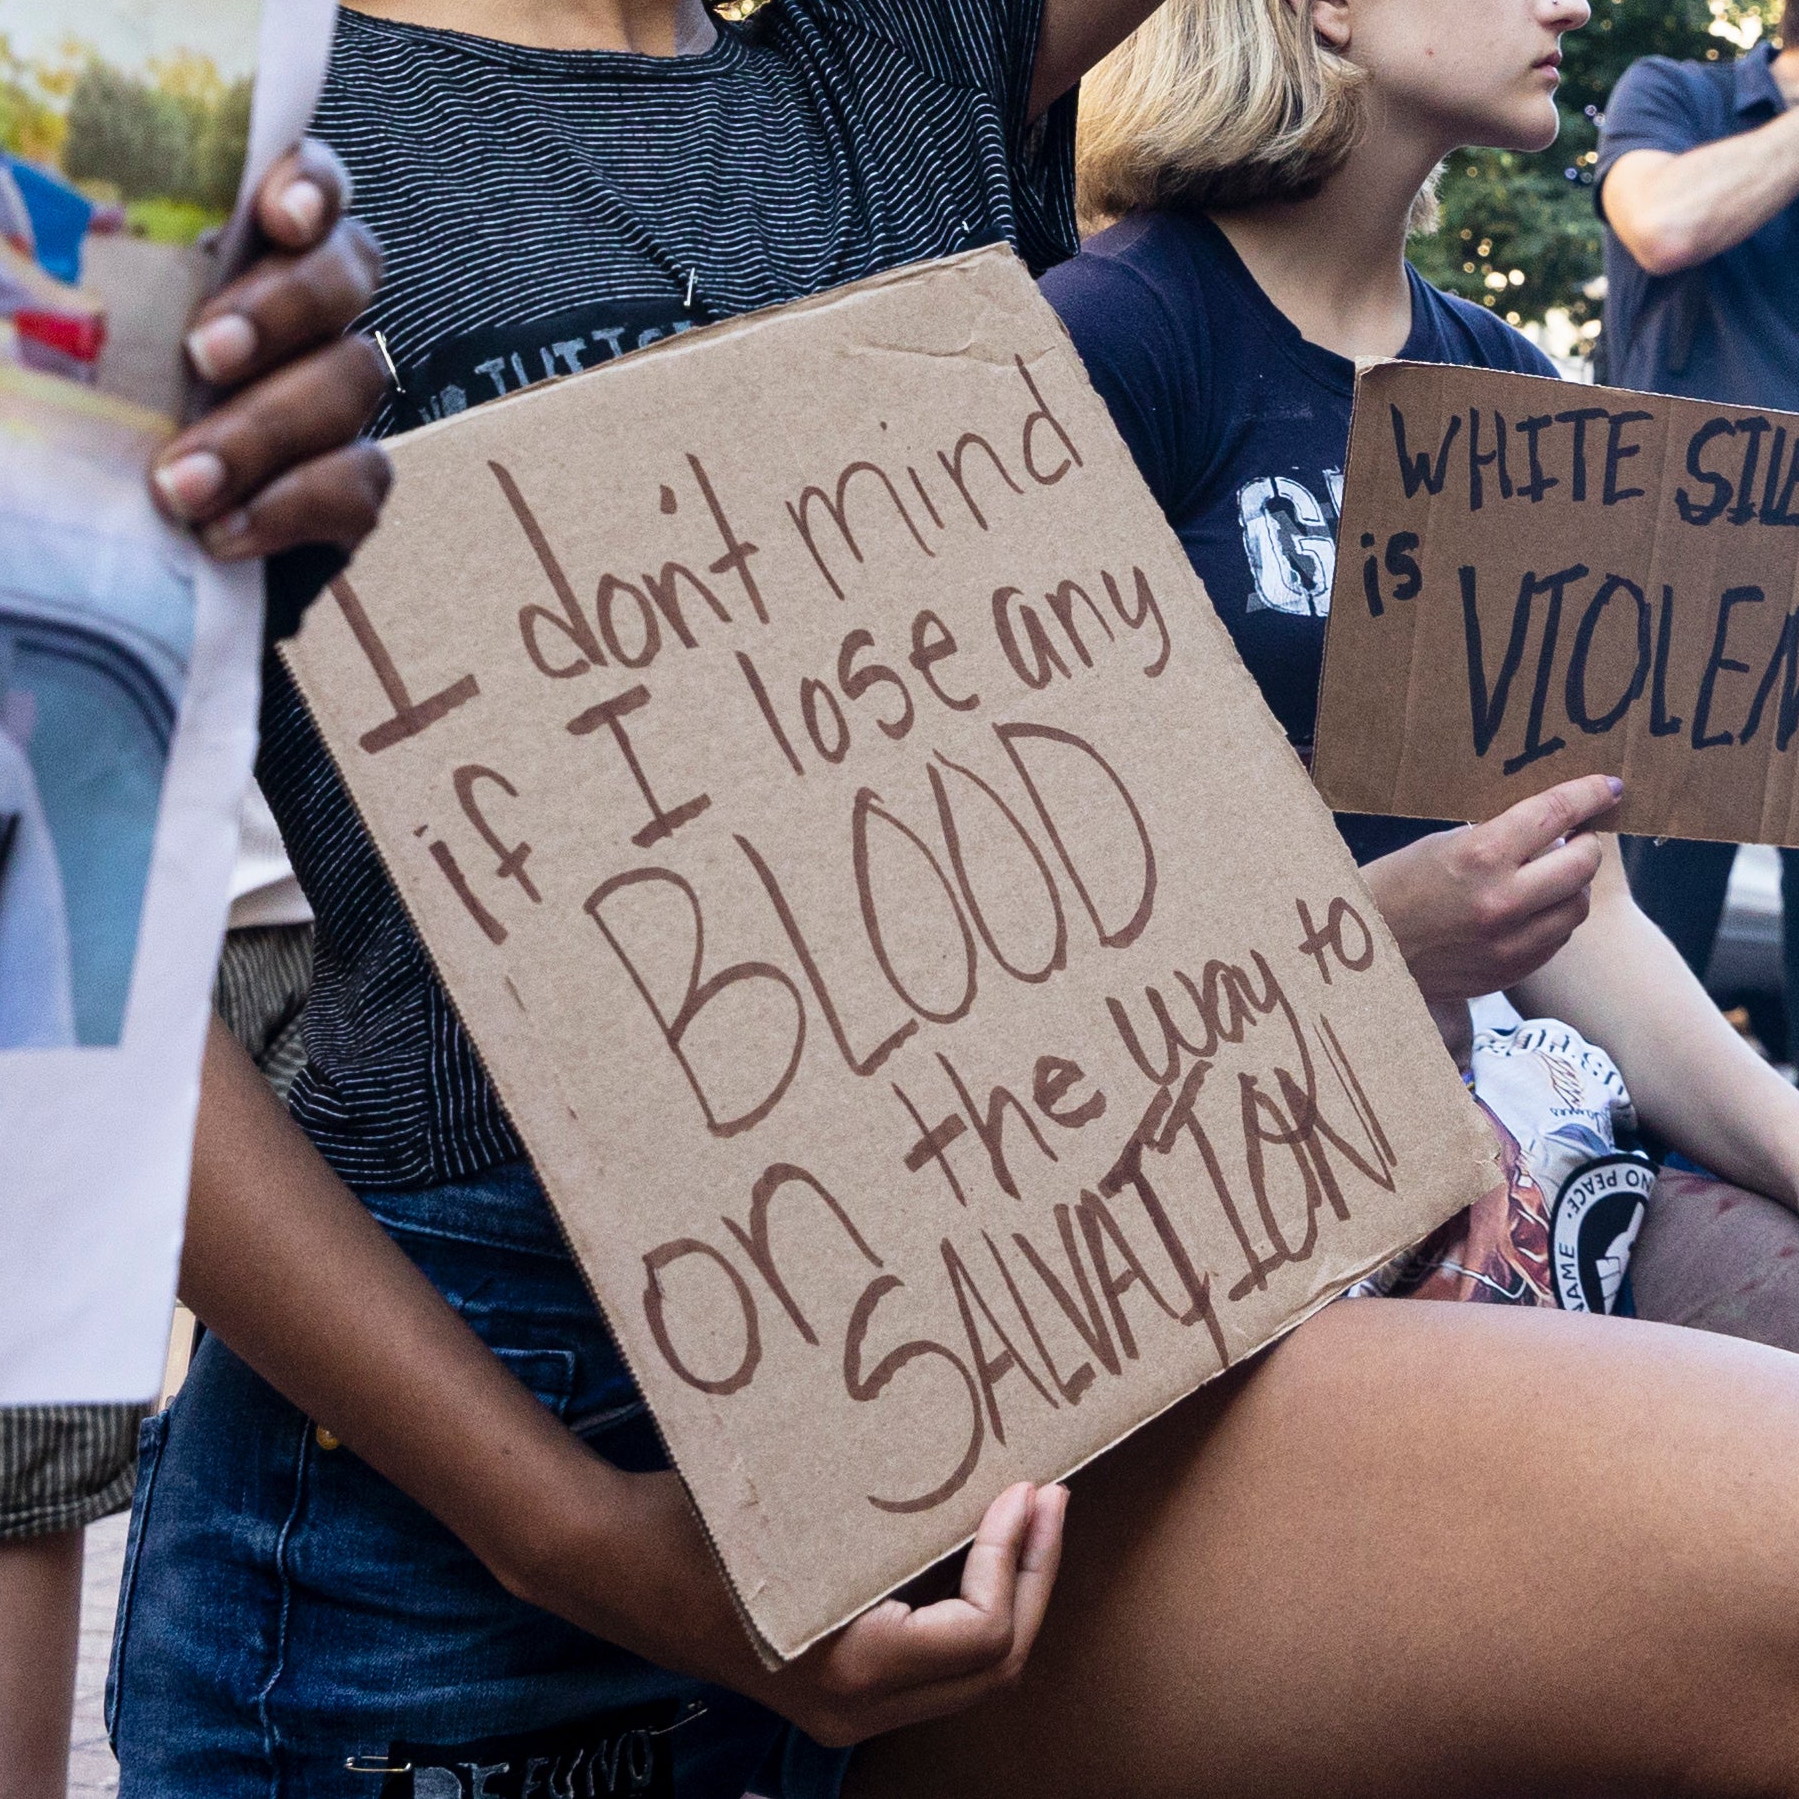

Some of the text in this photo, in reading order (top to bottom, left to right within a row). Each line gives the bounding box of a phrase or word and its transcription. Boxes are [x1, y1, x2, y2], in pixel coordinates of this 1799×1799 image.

[331, 571, 480, 753] I
[487, 452, 769, 679] don't
[786, 353, 1084, 600] mind
[1360, 532, 1422, 617] is
[1391, 403, 1653, 511] WHITE
[413, 566, 1171, 946] if I lose any
[584, 723, 1157, 1137] BLOOD
[641, 1163, 884, 1395] on
[891, 1053, 1106, 1205] the
[1106, 949, 1316, 1134] way
[1296, 897, 1375, 984] to
[844, 1013, 1397, 1514] SALVATION
